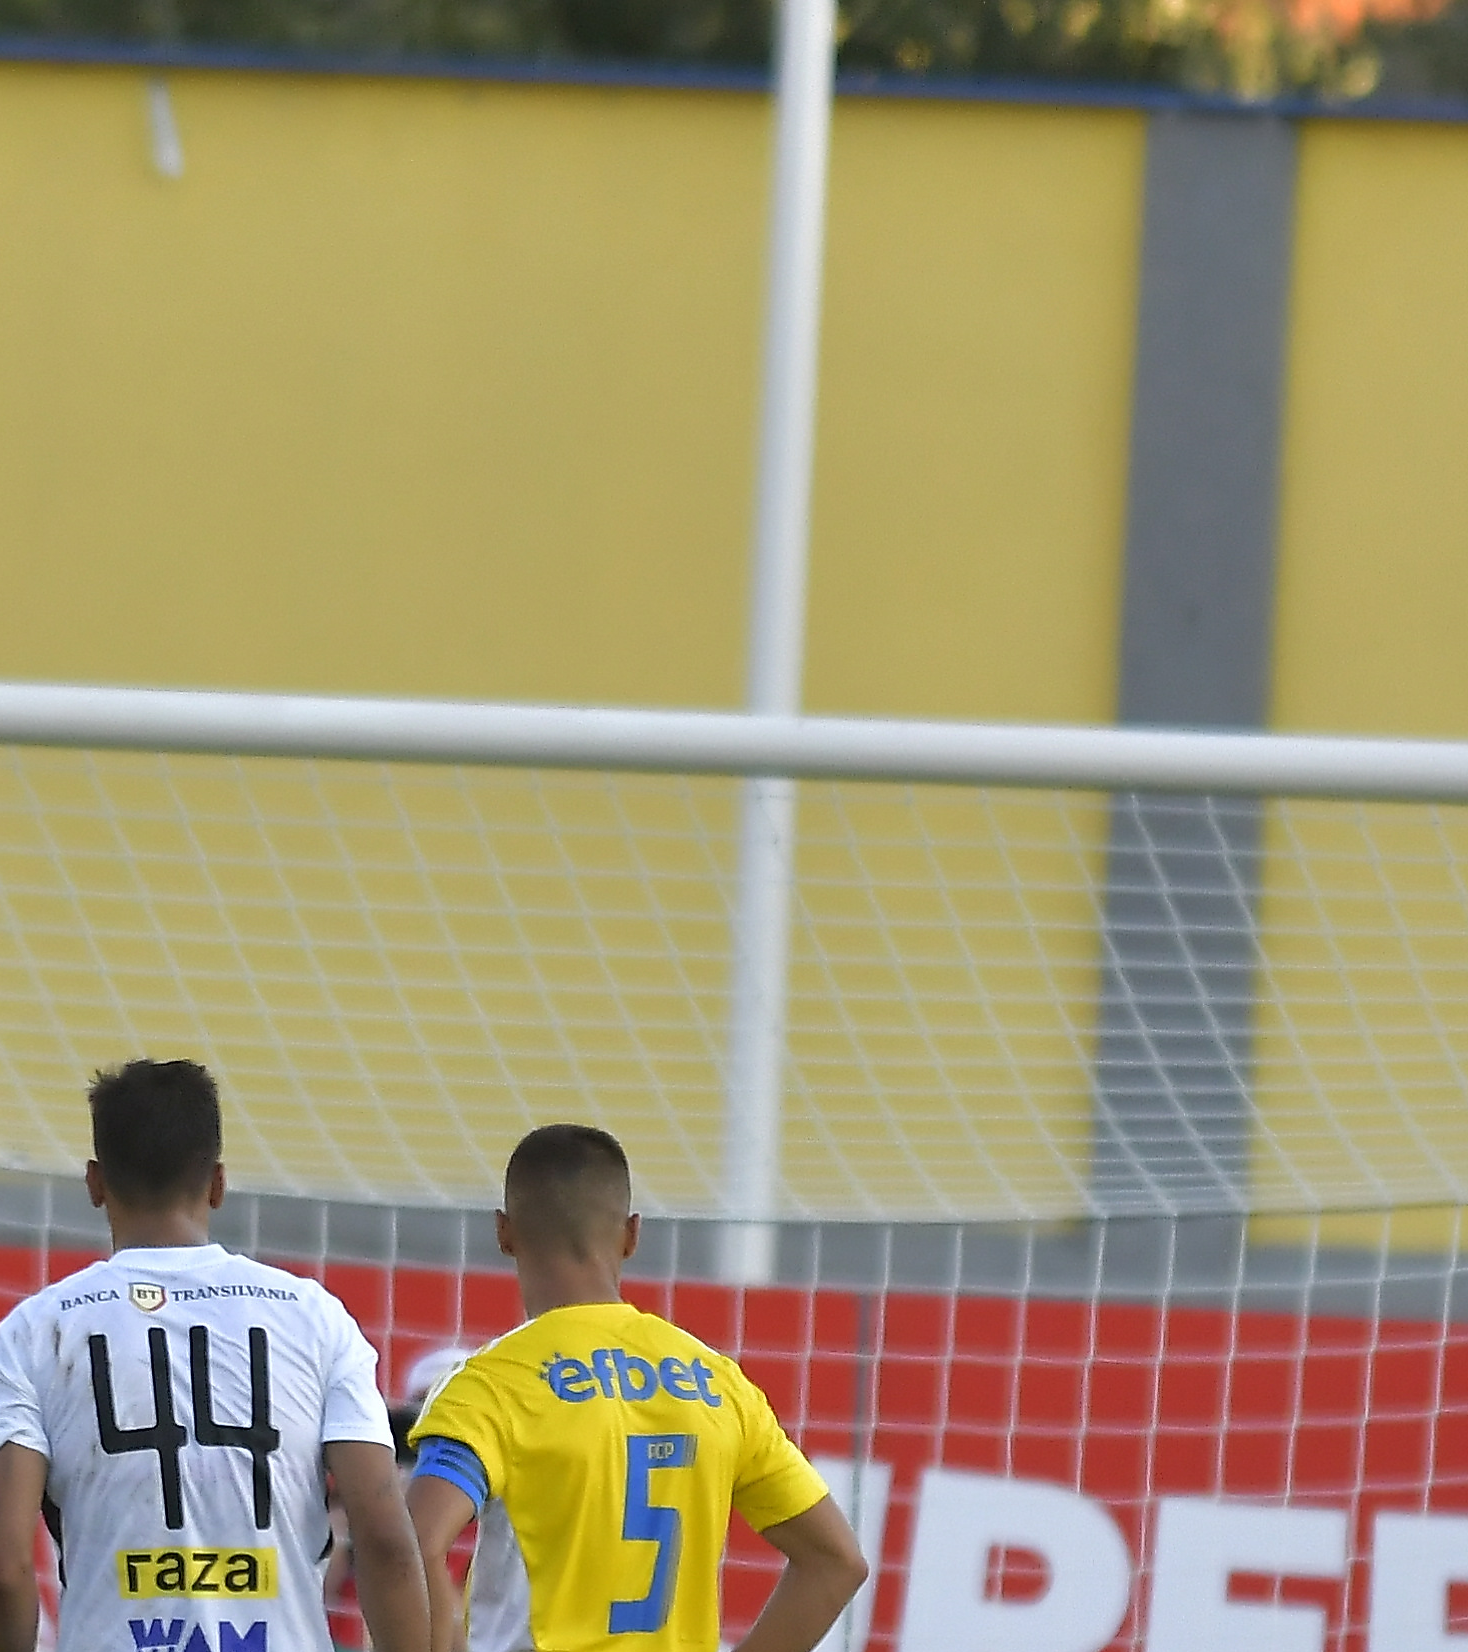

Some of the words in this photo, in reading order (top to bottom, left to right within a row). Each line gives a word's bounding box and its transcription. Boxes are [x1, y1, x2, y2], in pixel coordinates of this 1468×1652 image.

[61, 1290, 120, 1311] BANCA
[136, 1288, 160, 1301] BT
[171, 1285, 299, 1302] TRANSILVANIA
[542, 1348, 722, 1408] efbet
[88, 1325, 280, 1530] 44
[608, 1433, 698, 1634] 5
[126, 1551, 259, 1593] raza
